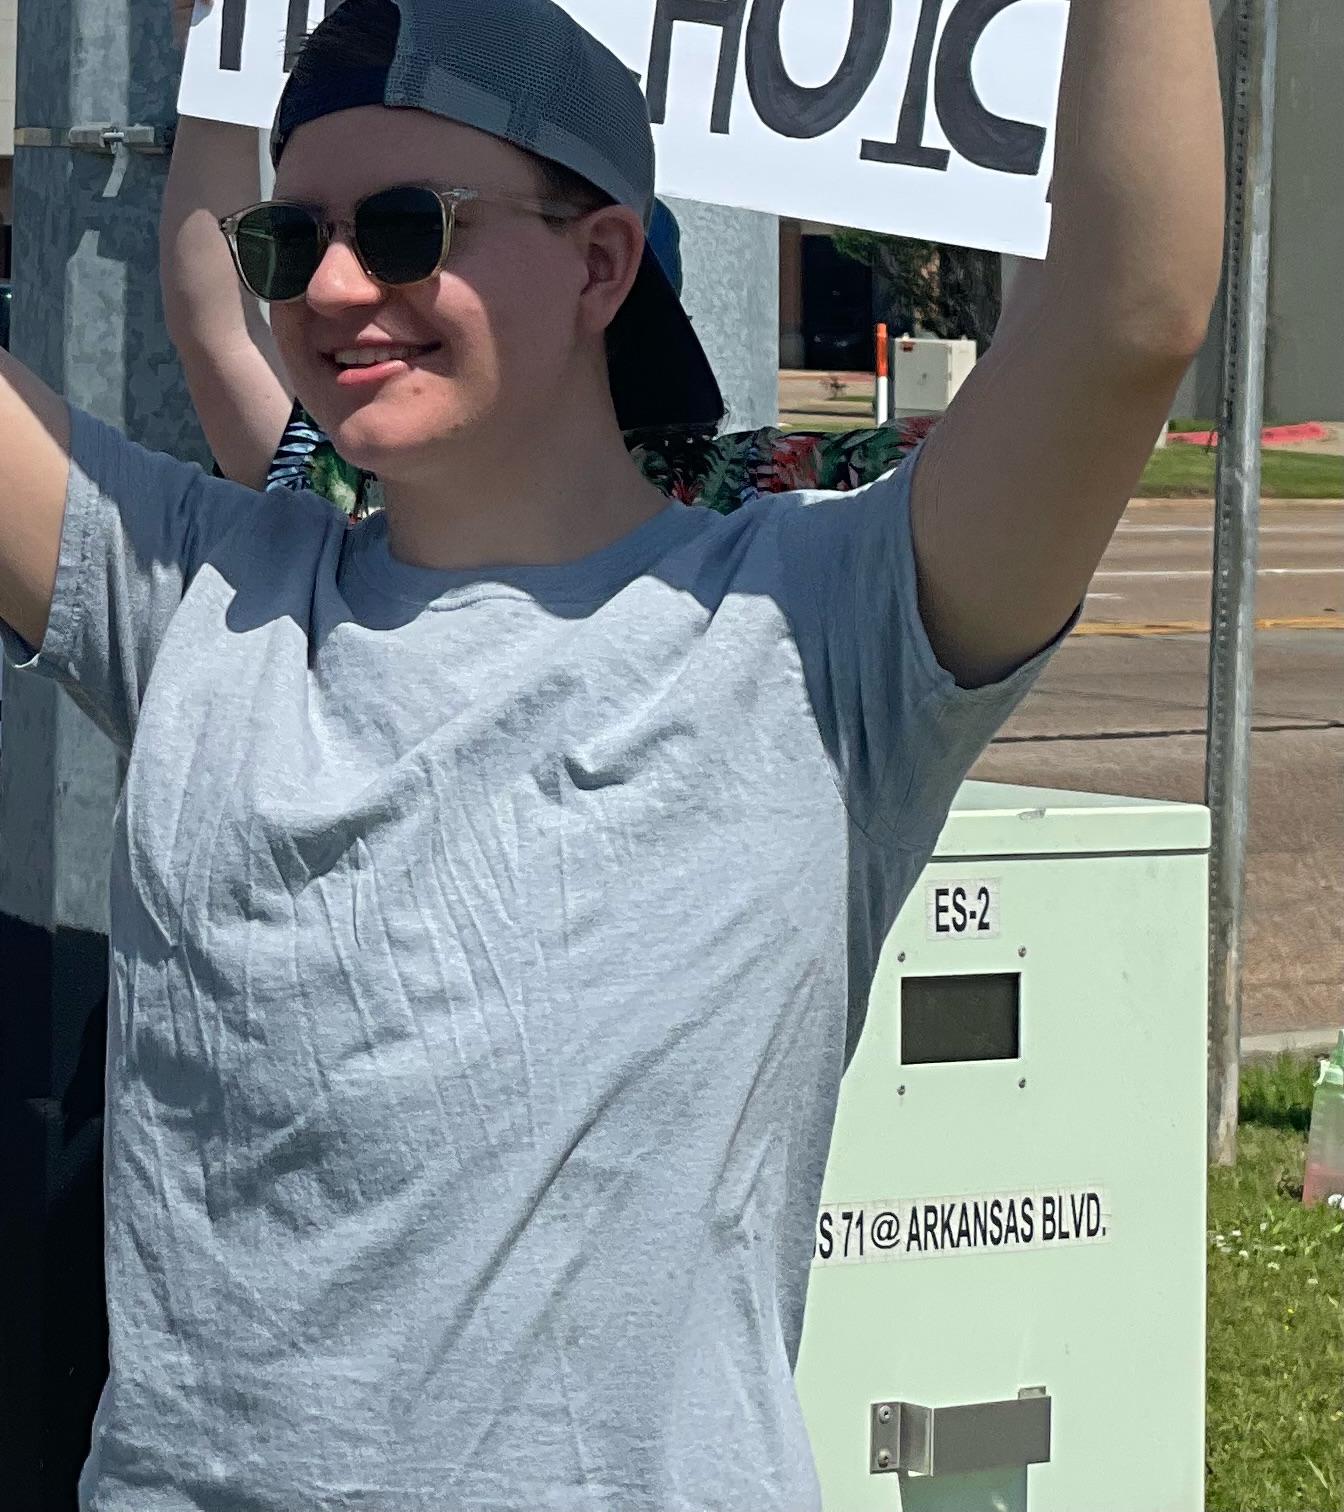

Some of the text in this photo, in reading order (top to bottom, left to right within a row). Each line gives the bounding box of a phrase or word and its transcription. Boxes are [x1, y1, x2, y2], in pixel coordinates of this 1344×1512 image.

[933, 886, 992, 934] ES-2
[841, 1209, 864, 1258] 71
[870, 1210, 901, 1250] @
[905, 1196, 1035, 1253] ARKANSAS
[1041, 1192, 1107, 1241] BLVD.
